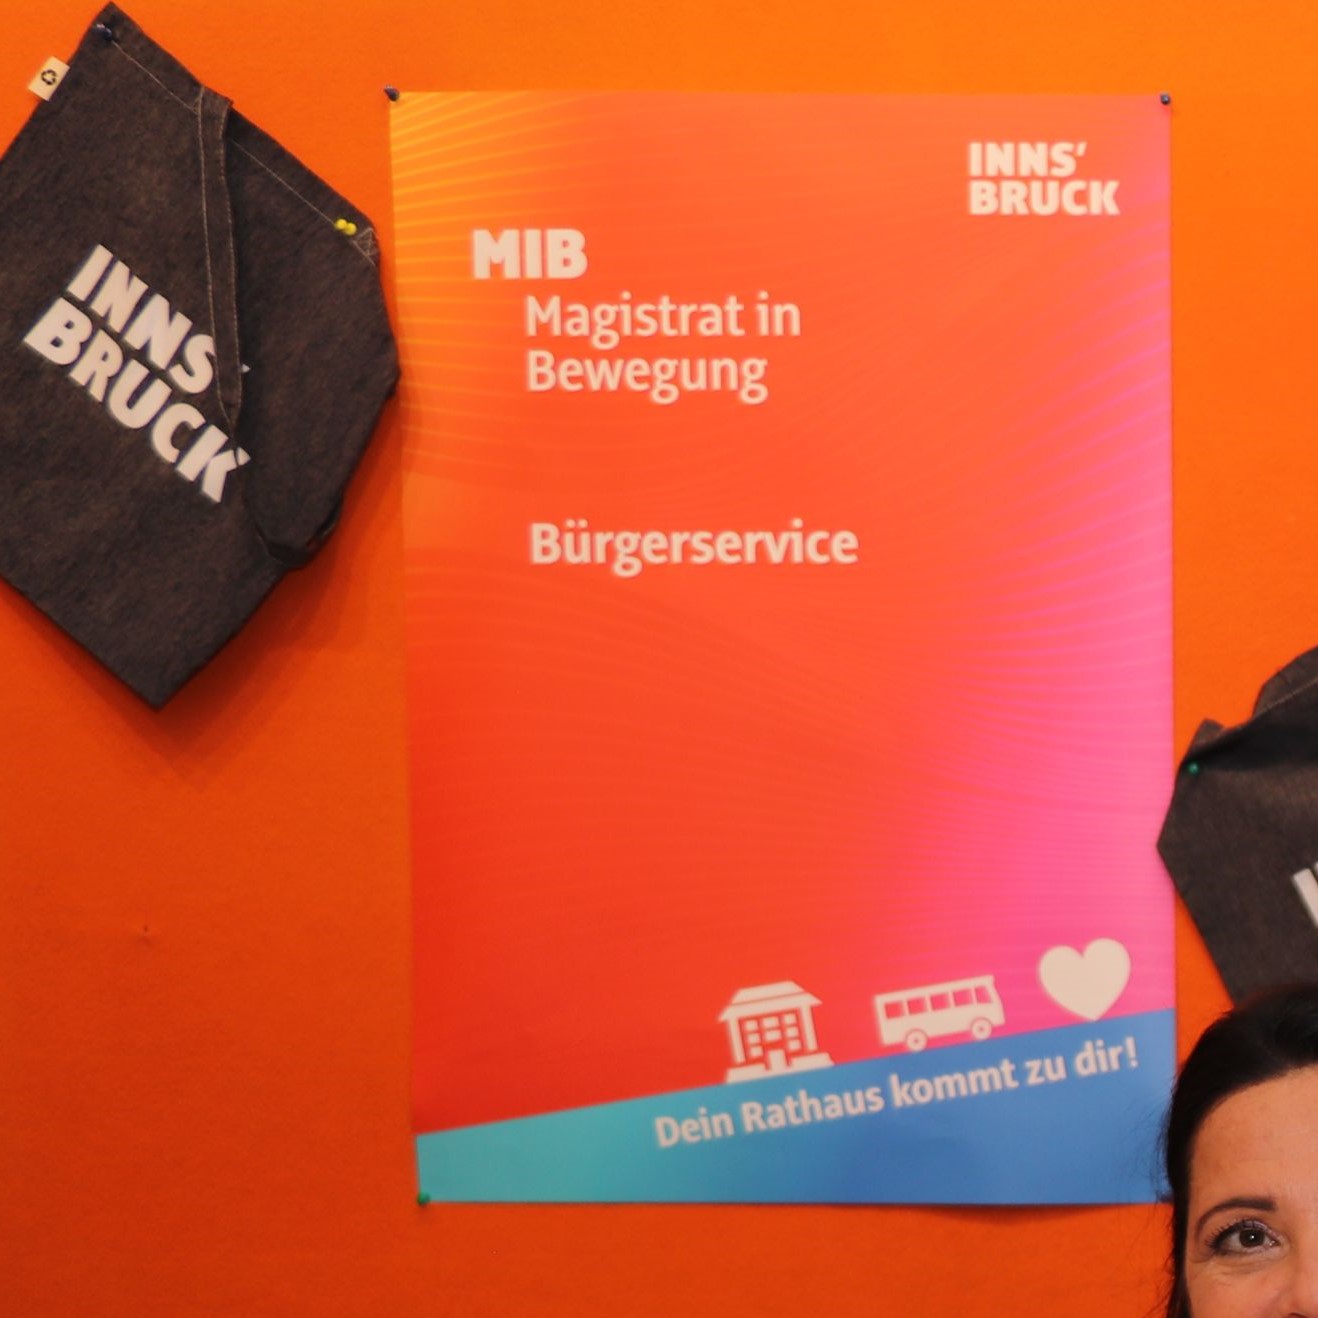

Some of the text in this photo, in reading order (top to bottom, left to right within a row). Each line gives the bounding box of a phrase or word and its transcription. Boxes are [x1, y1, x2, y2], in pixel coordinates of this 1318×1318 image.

[968, 141, 1087, 177] INNS'
[968, 180, 1121, 216] BRUCK
[472, 228, 588, 280] MIB
[526, 292, 801, 349] Magistrat in
[22, 296, 251, 504] BRUCK
[527, 349, 769, 404] Bewegung
[531, 519, 859, 576] Bürgerservice
[654, 1036, 1140, 1149] Dein Rathaus kommt zu dir!
